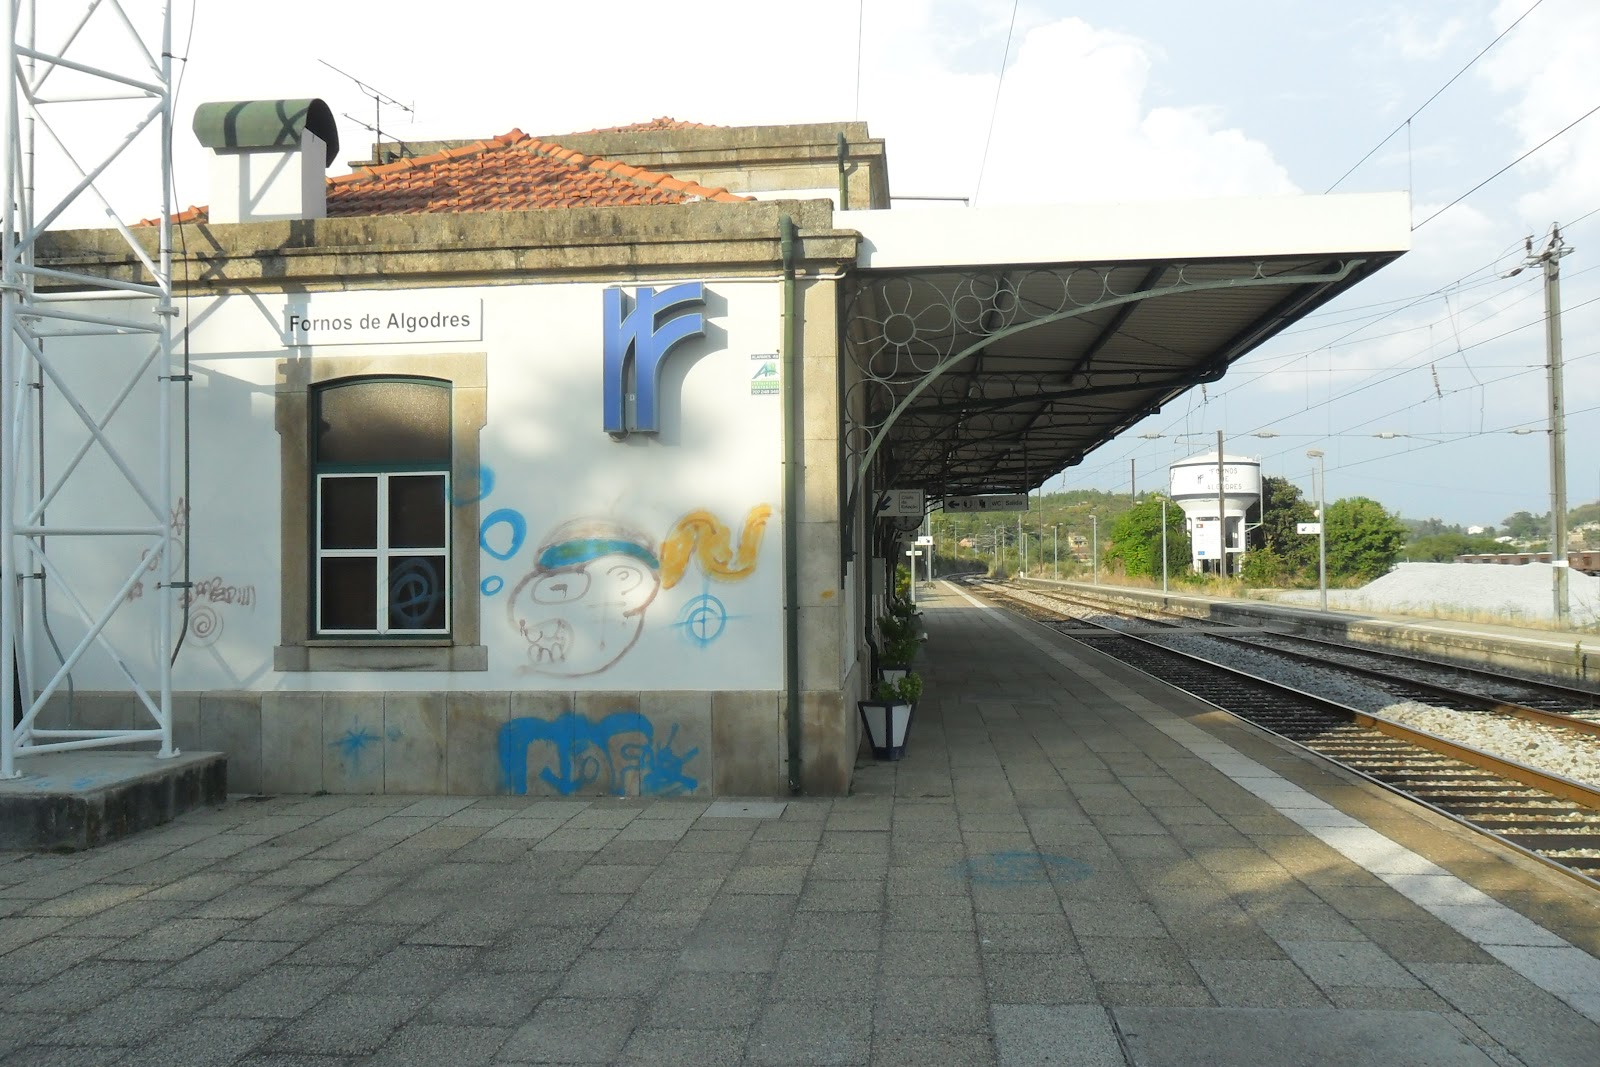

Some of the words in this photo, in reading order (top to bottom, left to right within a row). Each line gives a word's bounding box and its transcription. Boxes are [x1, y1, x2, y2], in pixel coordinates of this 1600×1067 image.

[290, 316, 353, 332] Fornos
[359, 314, 380, 330] de
[387, 312, 470, 333] Algodres
[1208, 467, 1238, 475] FONOS
